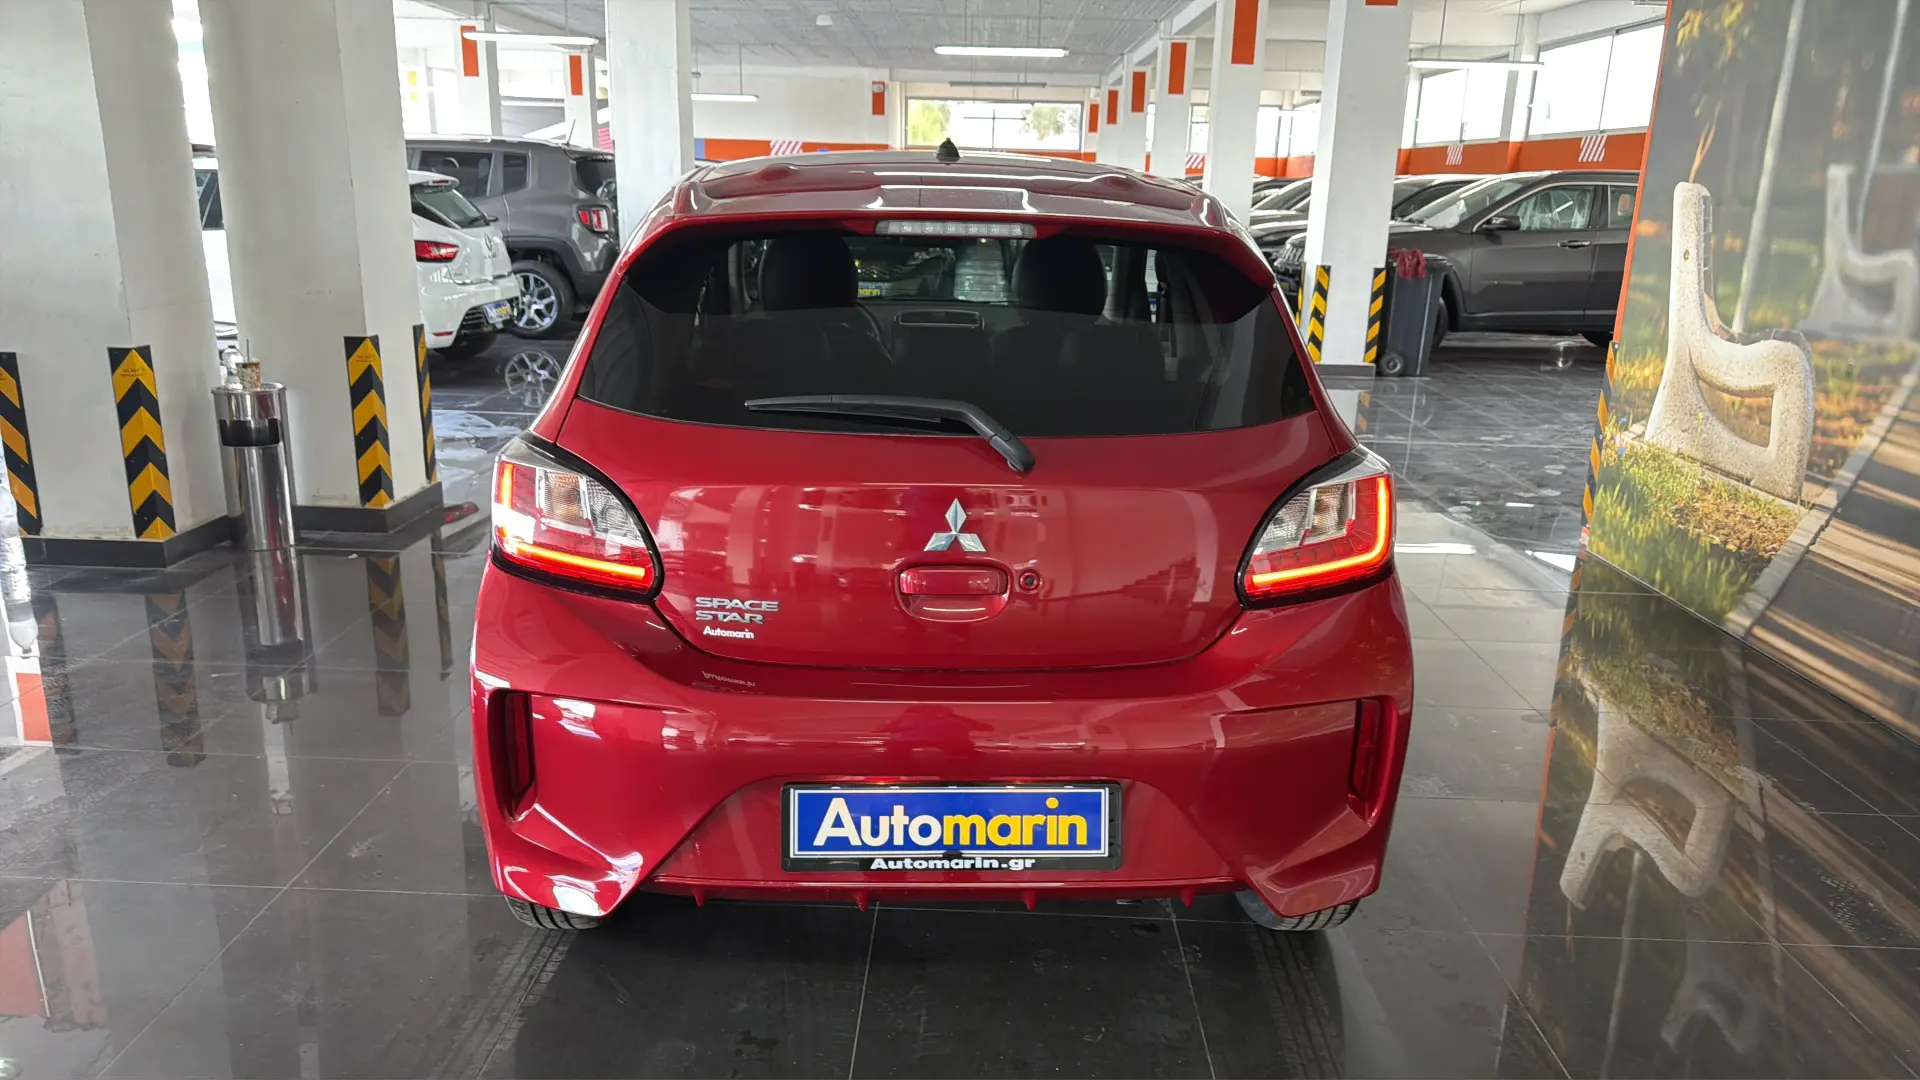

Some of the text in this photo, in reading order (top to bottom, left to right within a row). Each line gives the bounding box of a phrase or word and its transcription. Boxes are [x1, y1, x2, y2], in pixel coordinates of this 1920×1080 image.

[695, 597, 780, 611] SPACE
[695, 610, 764, 624] STAR
[703, 625, 754, 639] Automarin
[812, 797, 1088, 846] Automarin
[870, 857, 1036, 871] Automarin.gr
